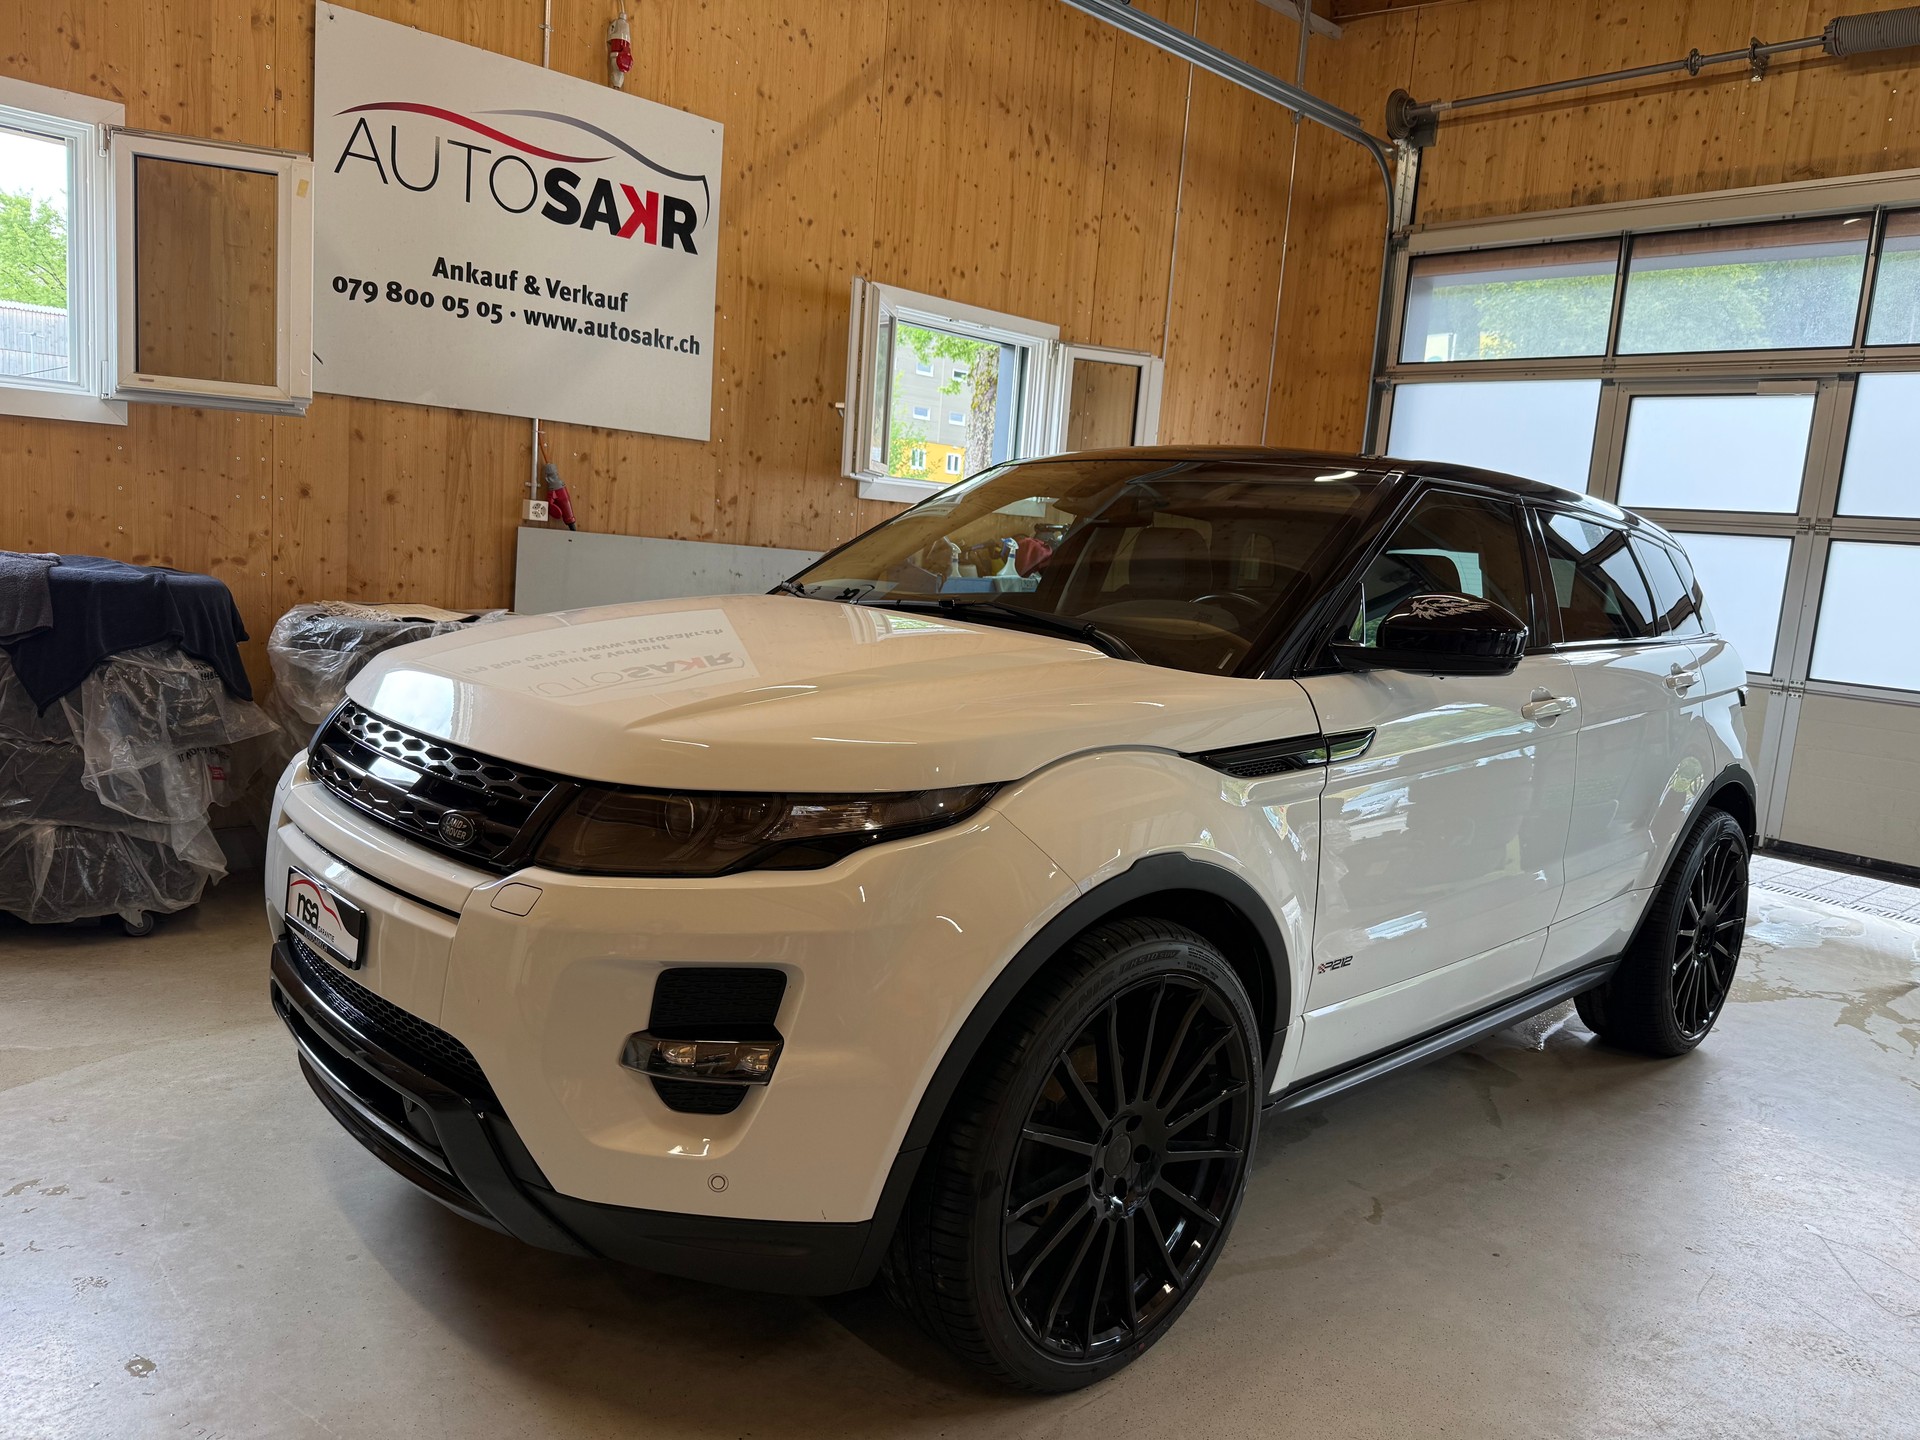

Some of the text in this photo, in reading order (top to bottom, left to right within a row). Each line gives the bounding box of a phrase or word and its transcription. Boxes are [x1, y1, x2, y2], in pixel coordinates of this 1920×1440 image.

[334, 117, 698, 255] AUTOSAKR
[432, 256, 629, 312] Ankauf & Verkauf
[332, 275, 701, 355] 079 800 05 05 www.autosakr.ch
[444, 825, 467, 840] ROVER
[445, 816, 464, 829] LAND
[296, 892, 320, 931] nsa
